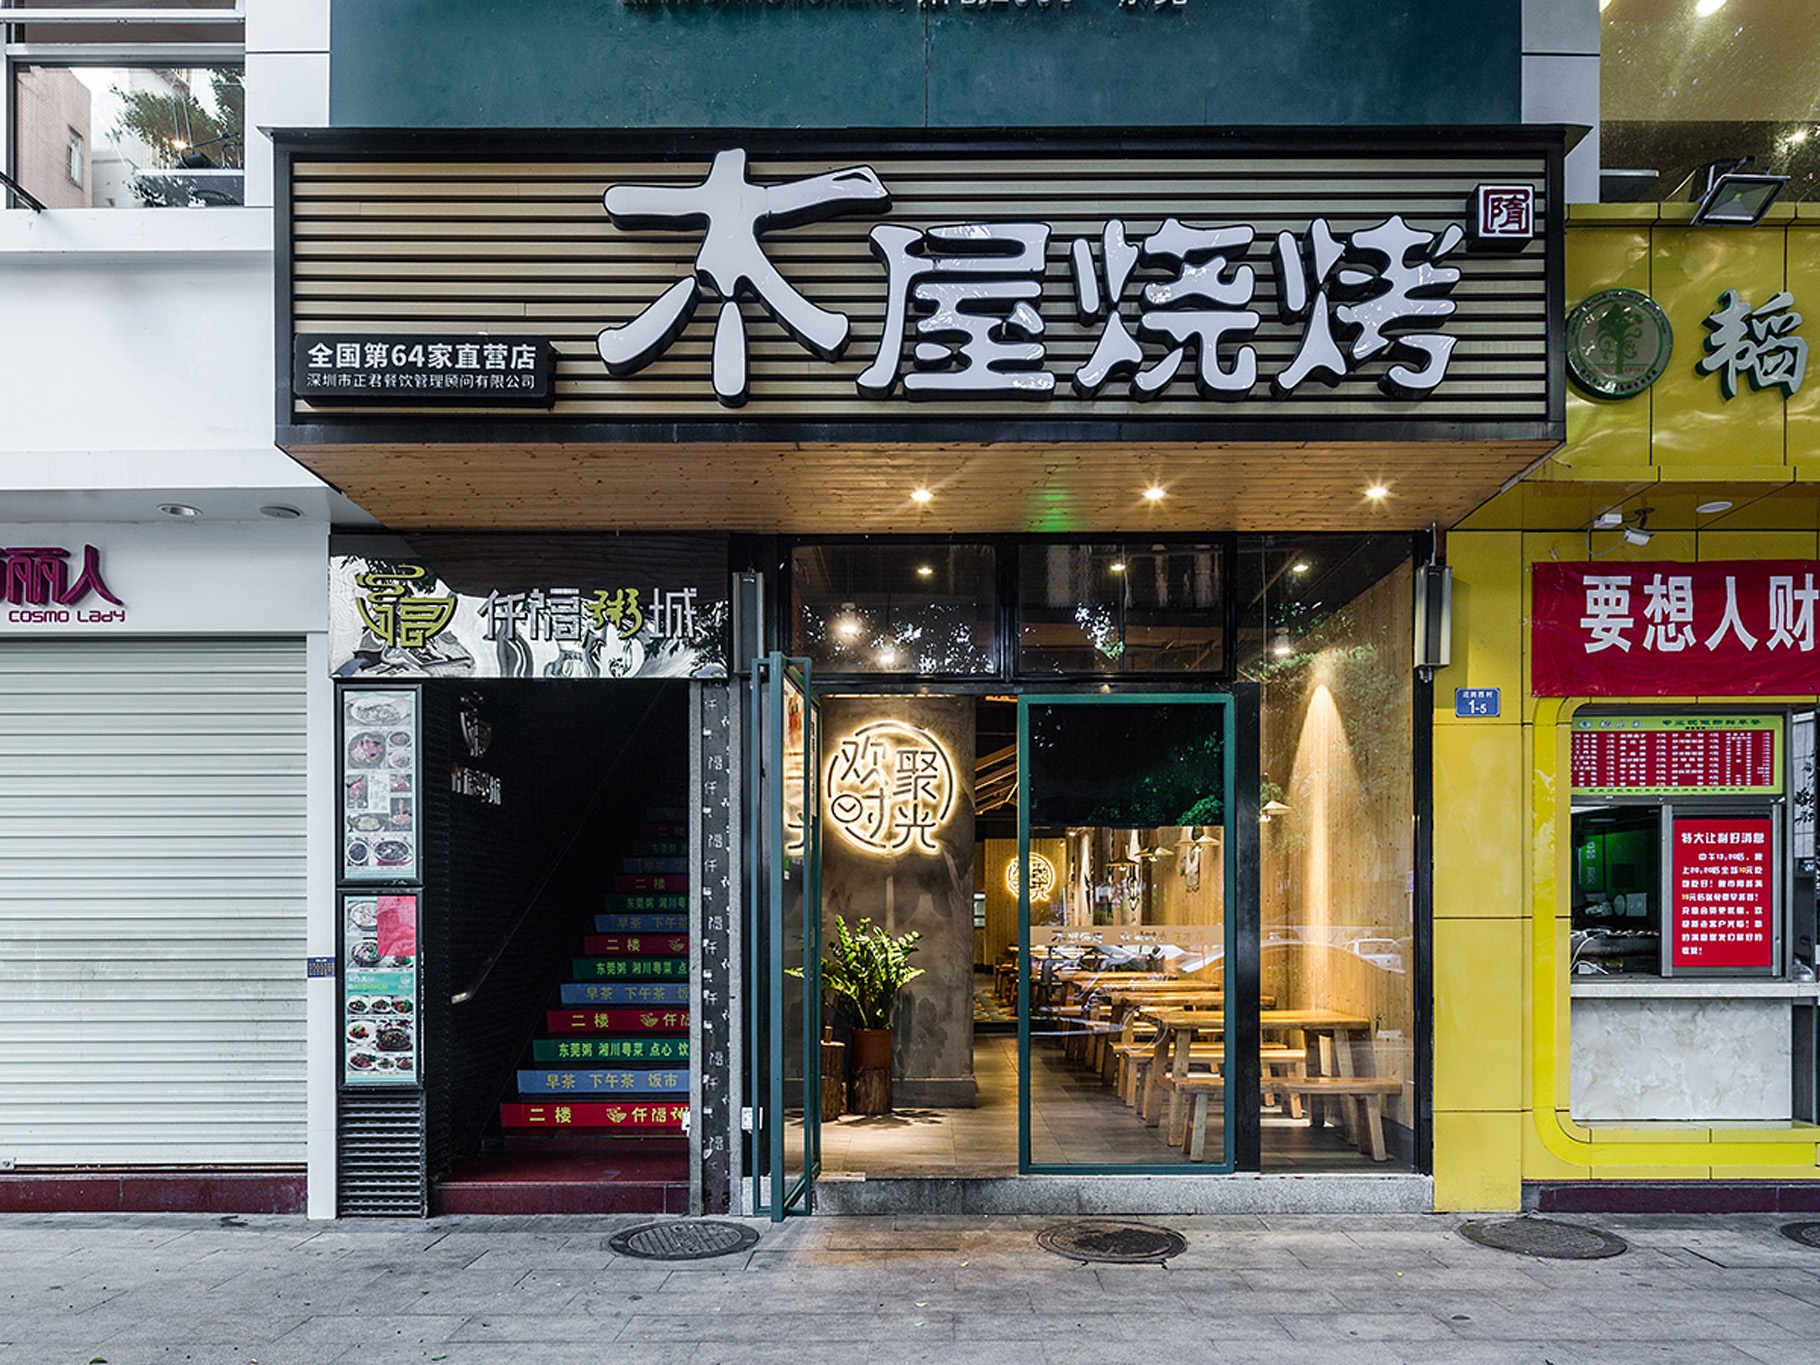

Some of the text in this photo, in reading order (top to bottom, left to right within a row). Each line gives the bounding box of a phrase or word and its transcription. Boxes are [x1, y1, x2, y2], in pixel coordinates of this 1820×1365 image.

[597, 148, 1463, 403] 木屋烧烤
[307, 342, 537, 371] 全国第64家直营店
[306, 373, 535, 390] 深圳市正君餐饮管理顾问有限公司
[0, 544, 124, 606] 丽人
[477, 588, 698, 641] 仟福粥城
[1579, 573, 1820, 653] 要想人财
[606, 938, 640, 952] 二楼
[596, 961, 627, 975] 东莞粥
[585, 986, 613, 1000] 早茶
[624, 986, 665, 1000] 下午茶
[571, 1013, 609, 1028] 二楼
[558, 1043, 592, 1057] 东莞粥
[598, 1043, 644, 1057] 湘川粤菜
[649, 1043, 673, 1057] 点心
[546, 1073, 678, 1089] 早茶 下午茶 饭市
[529, 1107, 572, 1123] 二楼
